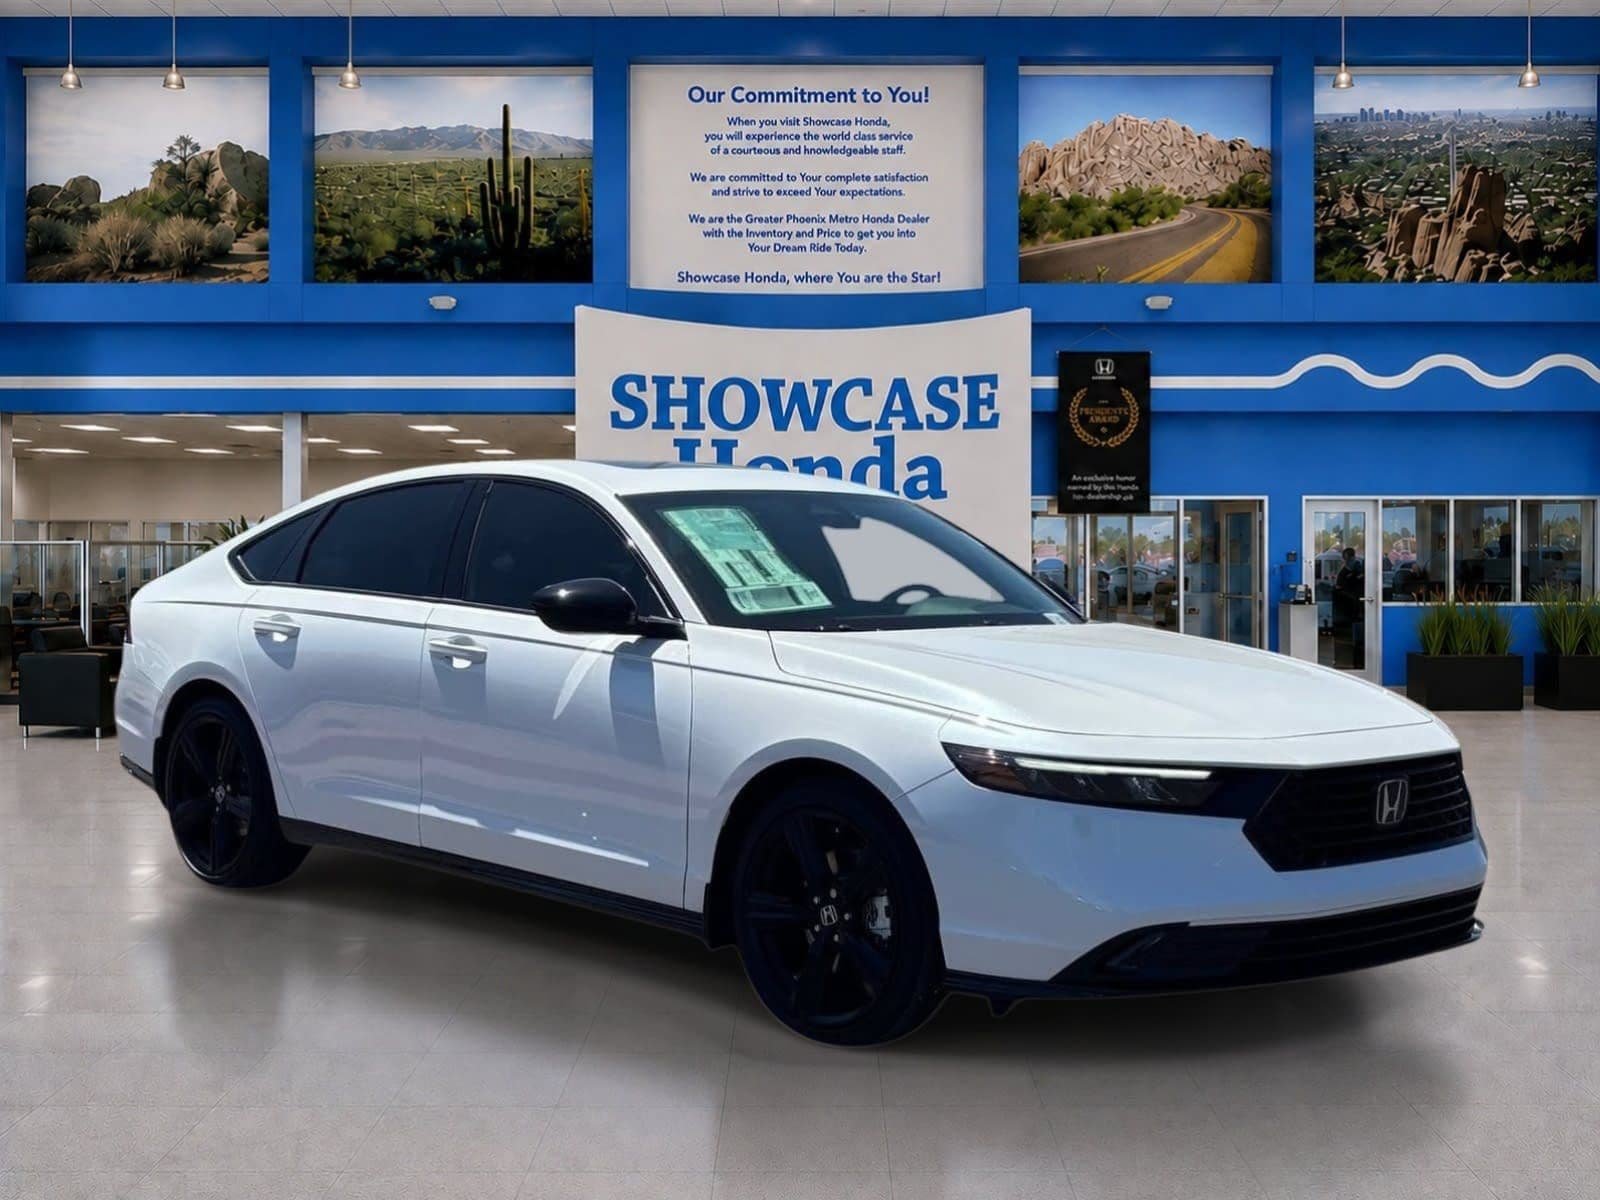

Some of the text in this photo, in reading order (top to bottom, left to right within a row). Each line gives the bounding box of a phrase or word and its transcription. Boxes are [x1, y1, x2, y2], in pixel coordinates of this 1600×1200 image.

[687, 85, 930, 104] Our Commitment to You!
[726, 115, 891, 129] When you visit Showcase Honda,
[704, 130, 914, 144] you will experience the world class service
[709, 144, 721, 155] of
[730, 146, 782, 156] courteous
[782, 144, 802, 156] and
[881, 144, 906, 155] staff.
[689, 171, 929, 185] We are committed to Your complete satisfaction
[711, 186, 906, 201] and strive to exceed Your expectations.
[688, 213, 931, 225] We are the Greater Phoenix Metro Honda Dealer
[702, 227, 917, 241] with the Inventory and Price to get you into
[747, 242, 867, 256] Your Dream Ride Today.
[677, 270, 941, 286] Showcase Honda, where You are the Star!
[610, 373, 1001, 432] SHOWCASE
